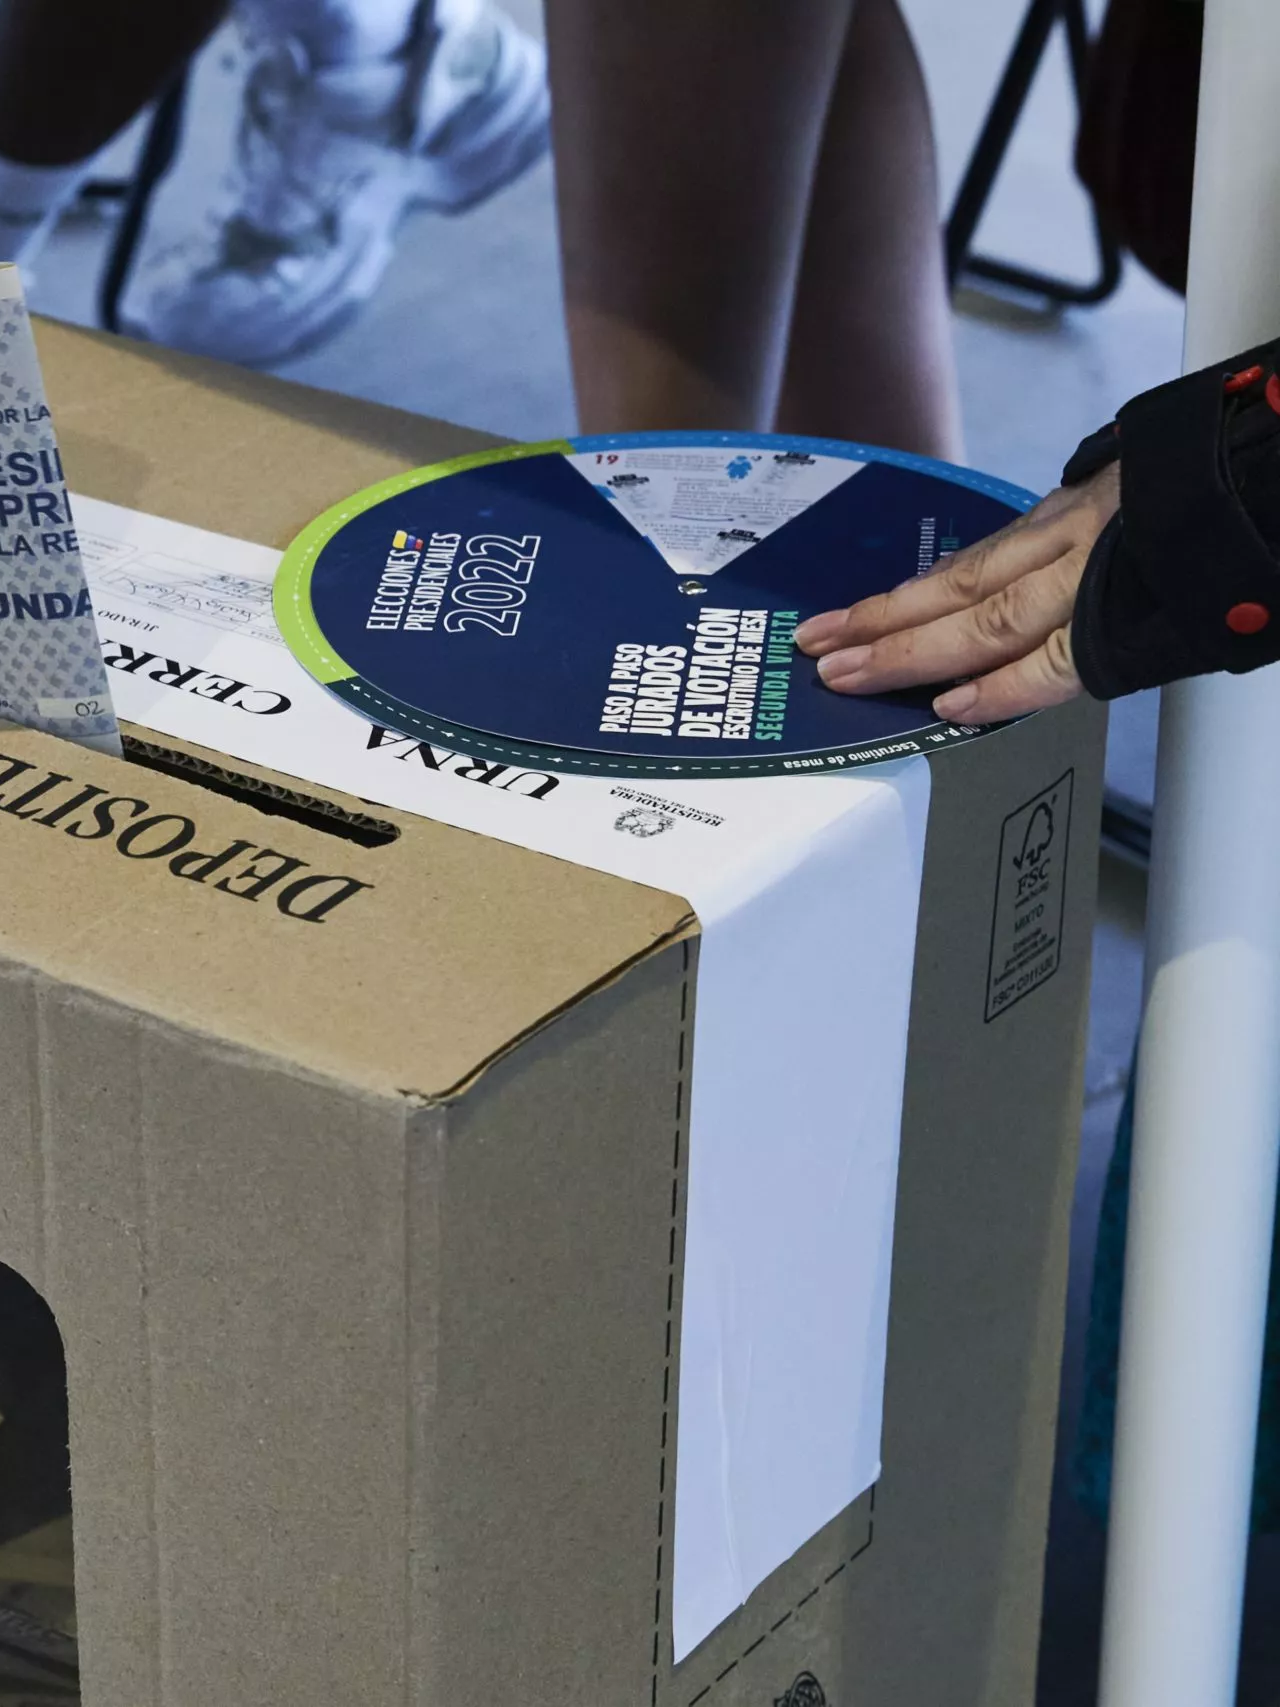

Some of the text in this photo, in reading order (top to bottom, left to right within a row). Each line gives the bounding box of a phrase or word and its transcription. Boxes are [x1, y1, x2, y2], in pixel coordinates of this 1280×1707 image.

[24, 405, 52, 422] LA
[595, 454, 619, 465] 19
[366, 549, 421, 630] ELECCIONES
[403, 532, 462, 631] PRESIDENCIALES
[443, 534, 541, 637] 2022
[98, 609, 159, 632] JURADO
[683, 607, 741, 706] VOTACIÓN
[75, 701, 105, 717] 02
[100, 638, 292, 715] CERR
[599, 643, 645, 733] PASO A PASO
[629, 644, 688, 737] JURADOS
[722, 609, 768, 740] ESCRUTINIO DE MESA
[755, 610, 799, 741] SEGUNDA VUELTA
[366, 724, 560, 801] URNA
[678, 711, 723, 739] DE
[828, 755, 846, 765] de
[848, 741, 921, 761] Escrutinio
[783, 759, 825, 769] mesa
[1017, 858, 1051, 898] FSC
